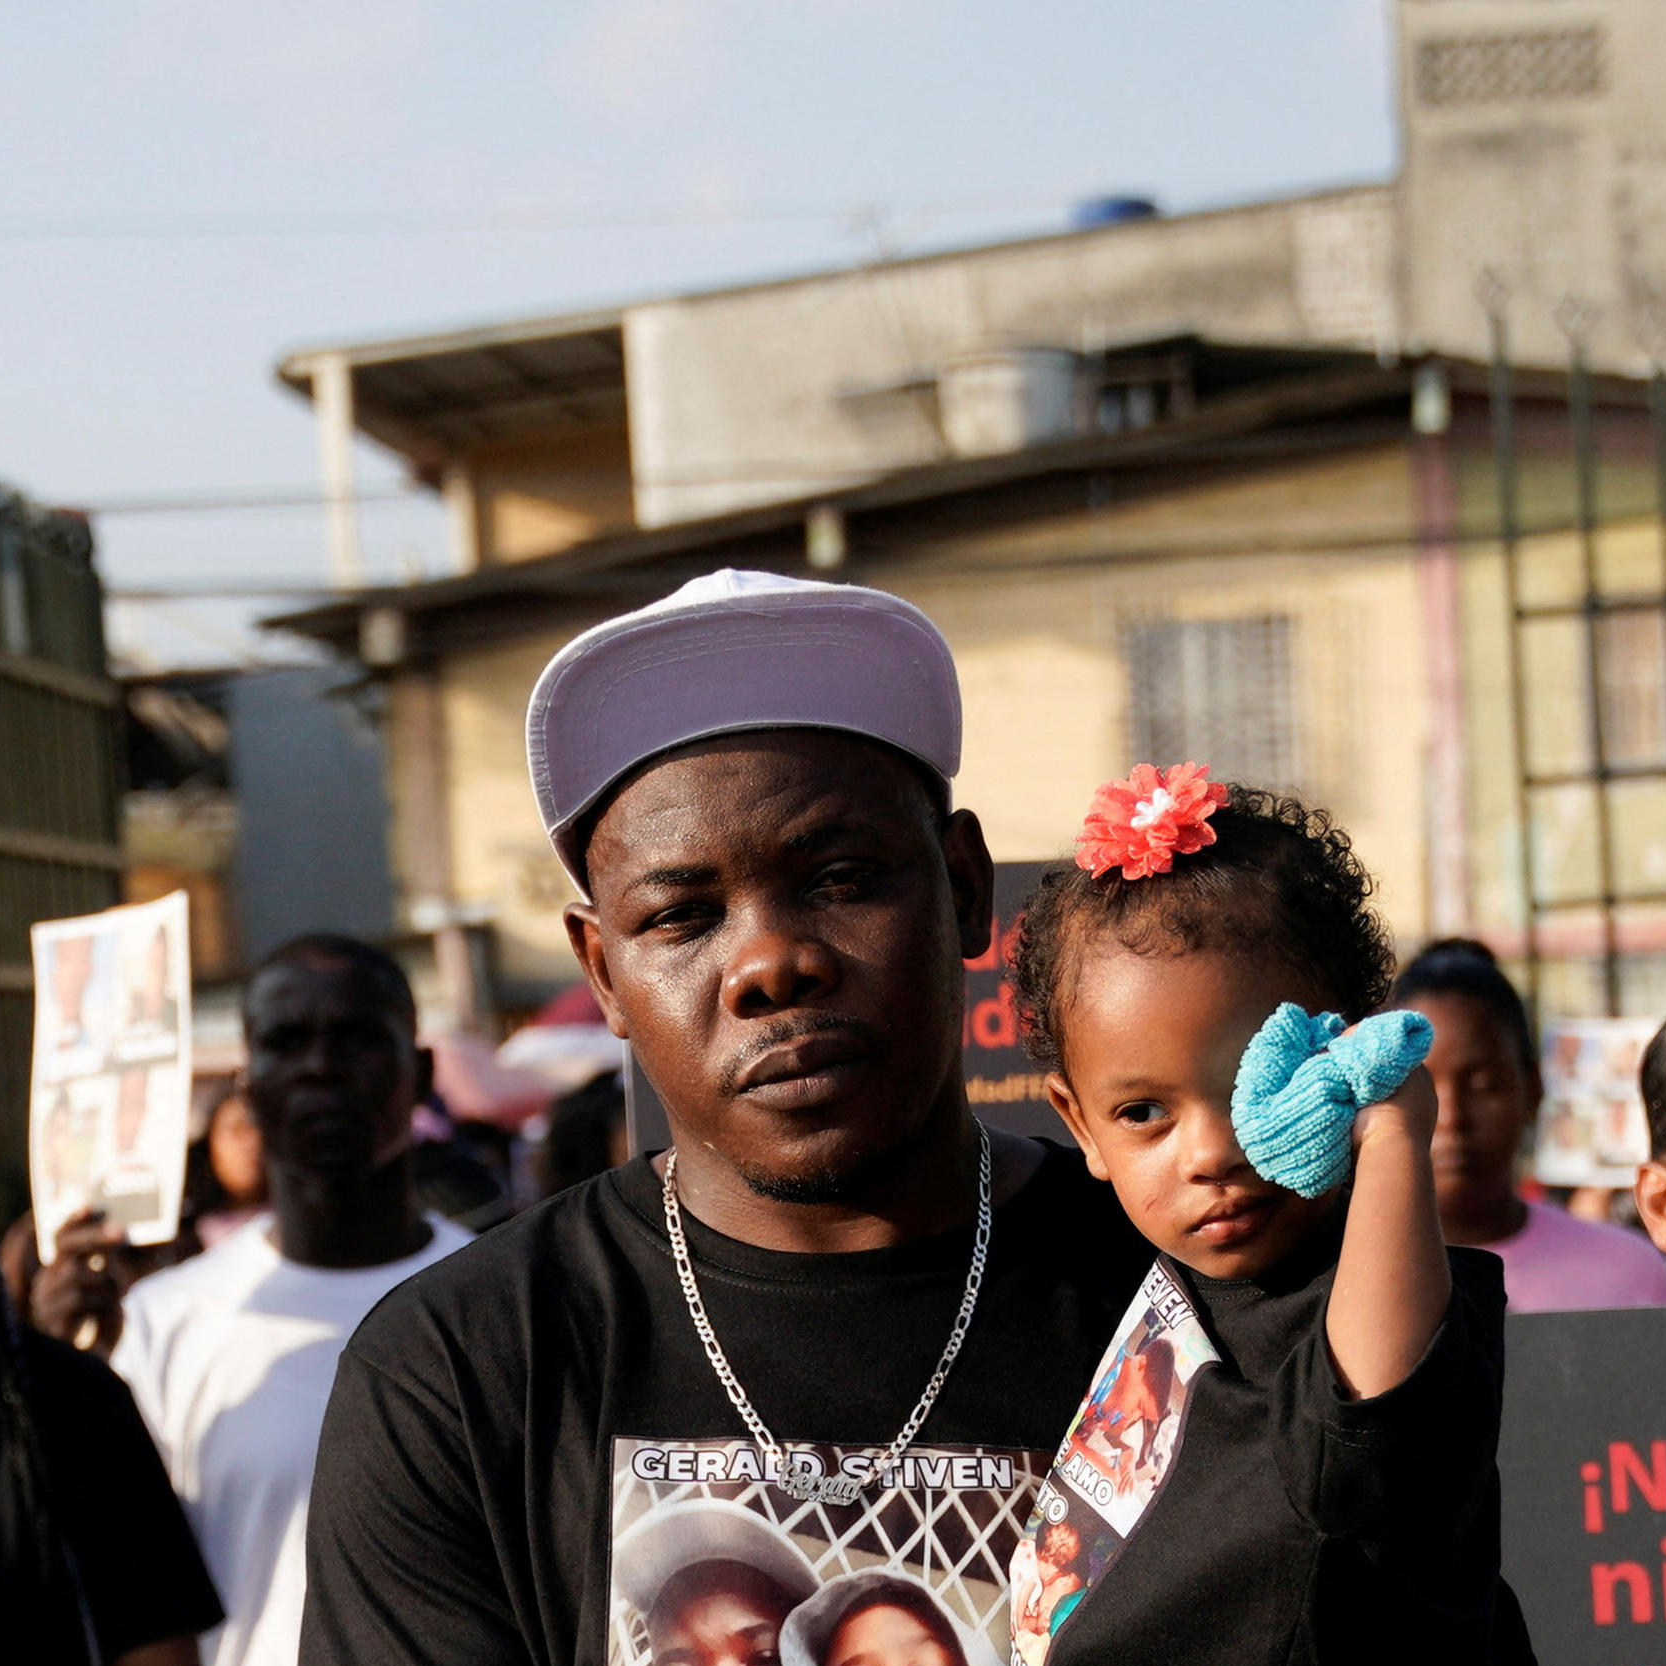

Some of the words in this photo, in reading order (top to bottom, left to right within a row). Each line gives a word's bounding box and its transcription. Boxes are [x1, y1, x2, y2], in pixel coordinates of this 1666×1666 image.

[633, 1447, 825, 1484] GERALD
[840, 1453, 1015, 1491] STIVEN
[1063, 1452, 1115, 1508] AMO
